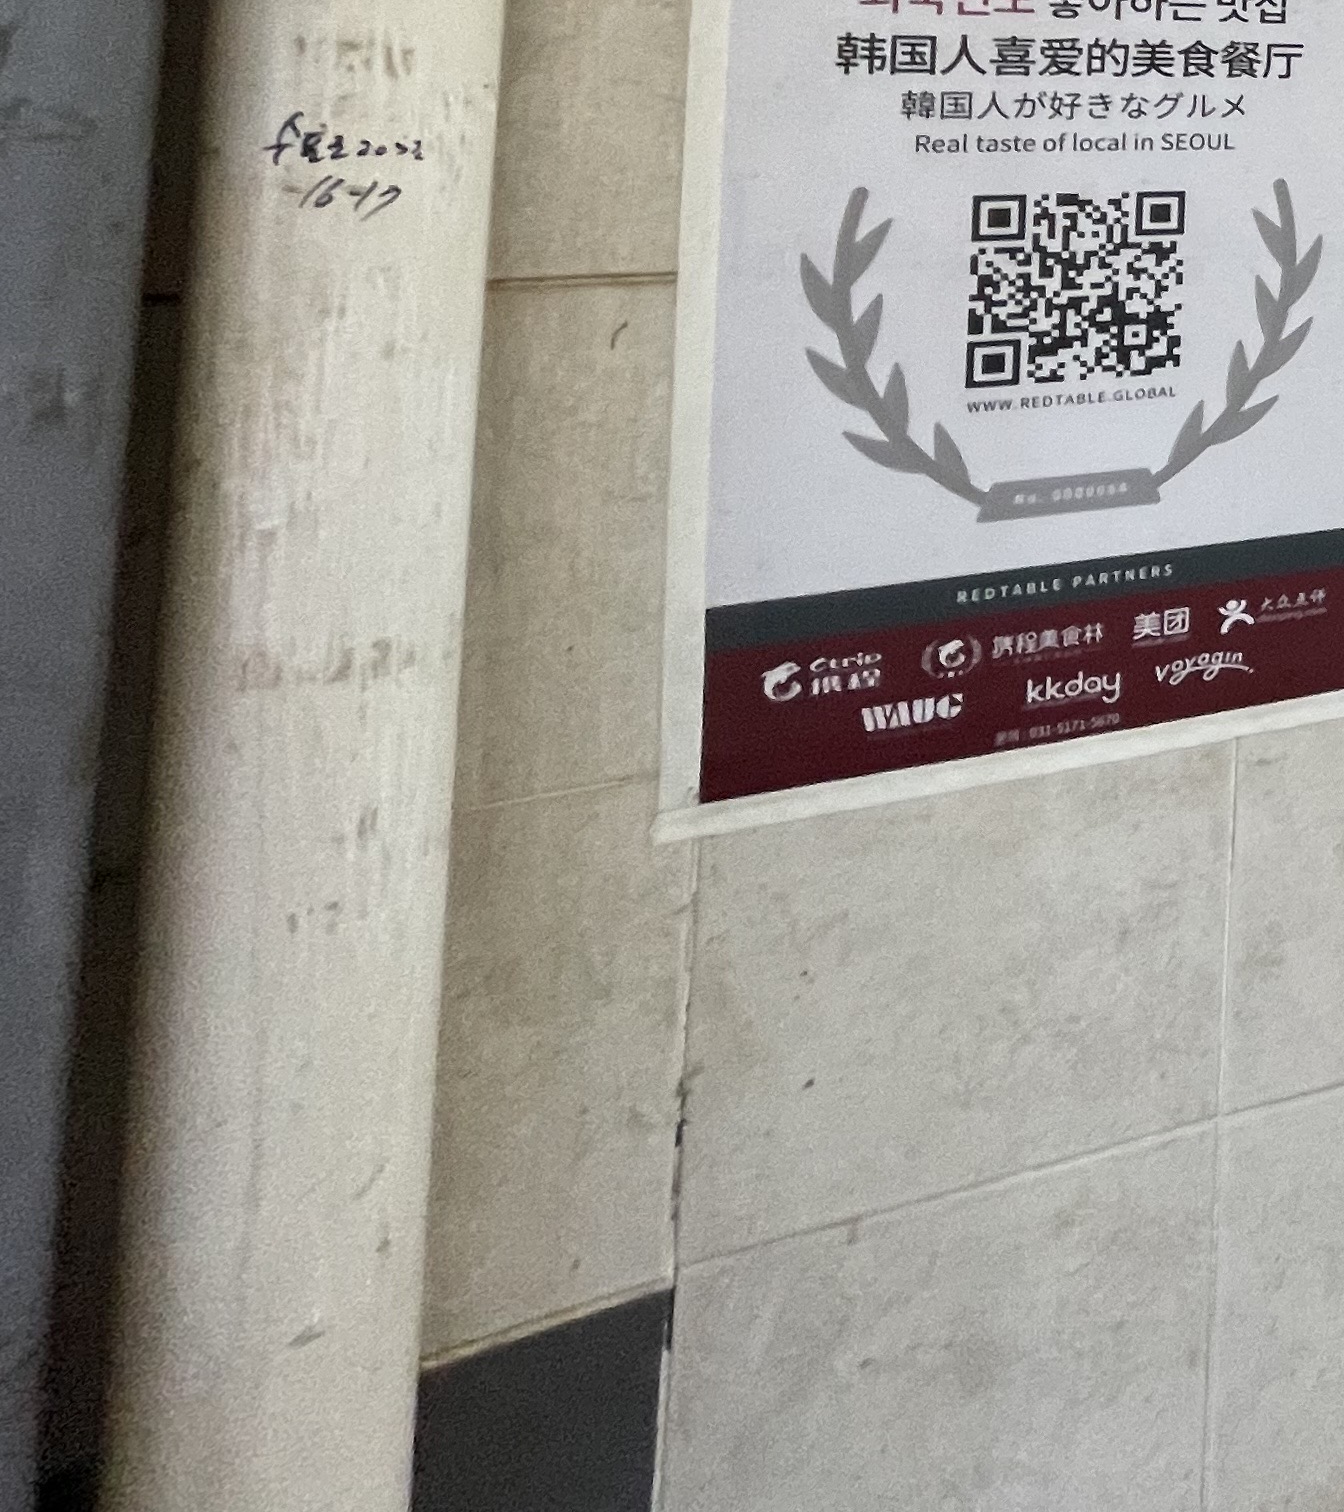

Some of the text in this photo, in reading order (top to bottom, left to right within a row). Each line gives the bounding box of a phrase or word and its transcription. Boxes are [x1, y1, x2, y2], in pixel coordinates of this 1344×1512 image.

[836, 32, 1305, 82] 韩国人喜爱的美食餐厅
[900, 89, 1247, 123] 韓国人が好きなグルメ
[914, 130, 1237, 155] Real taste of local in SEOUL
[956, 563, 1174, 604] REDTABLE PARTNERS
[1132, 606, 1191, 640] 美团
[1026, 670, 1122, 704] kkday
